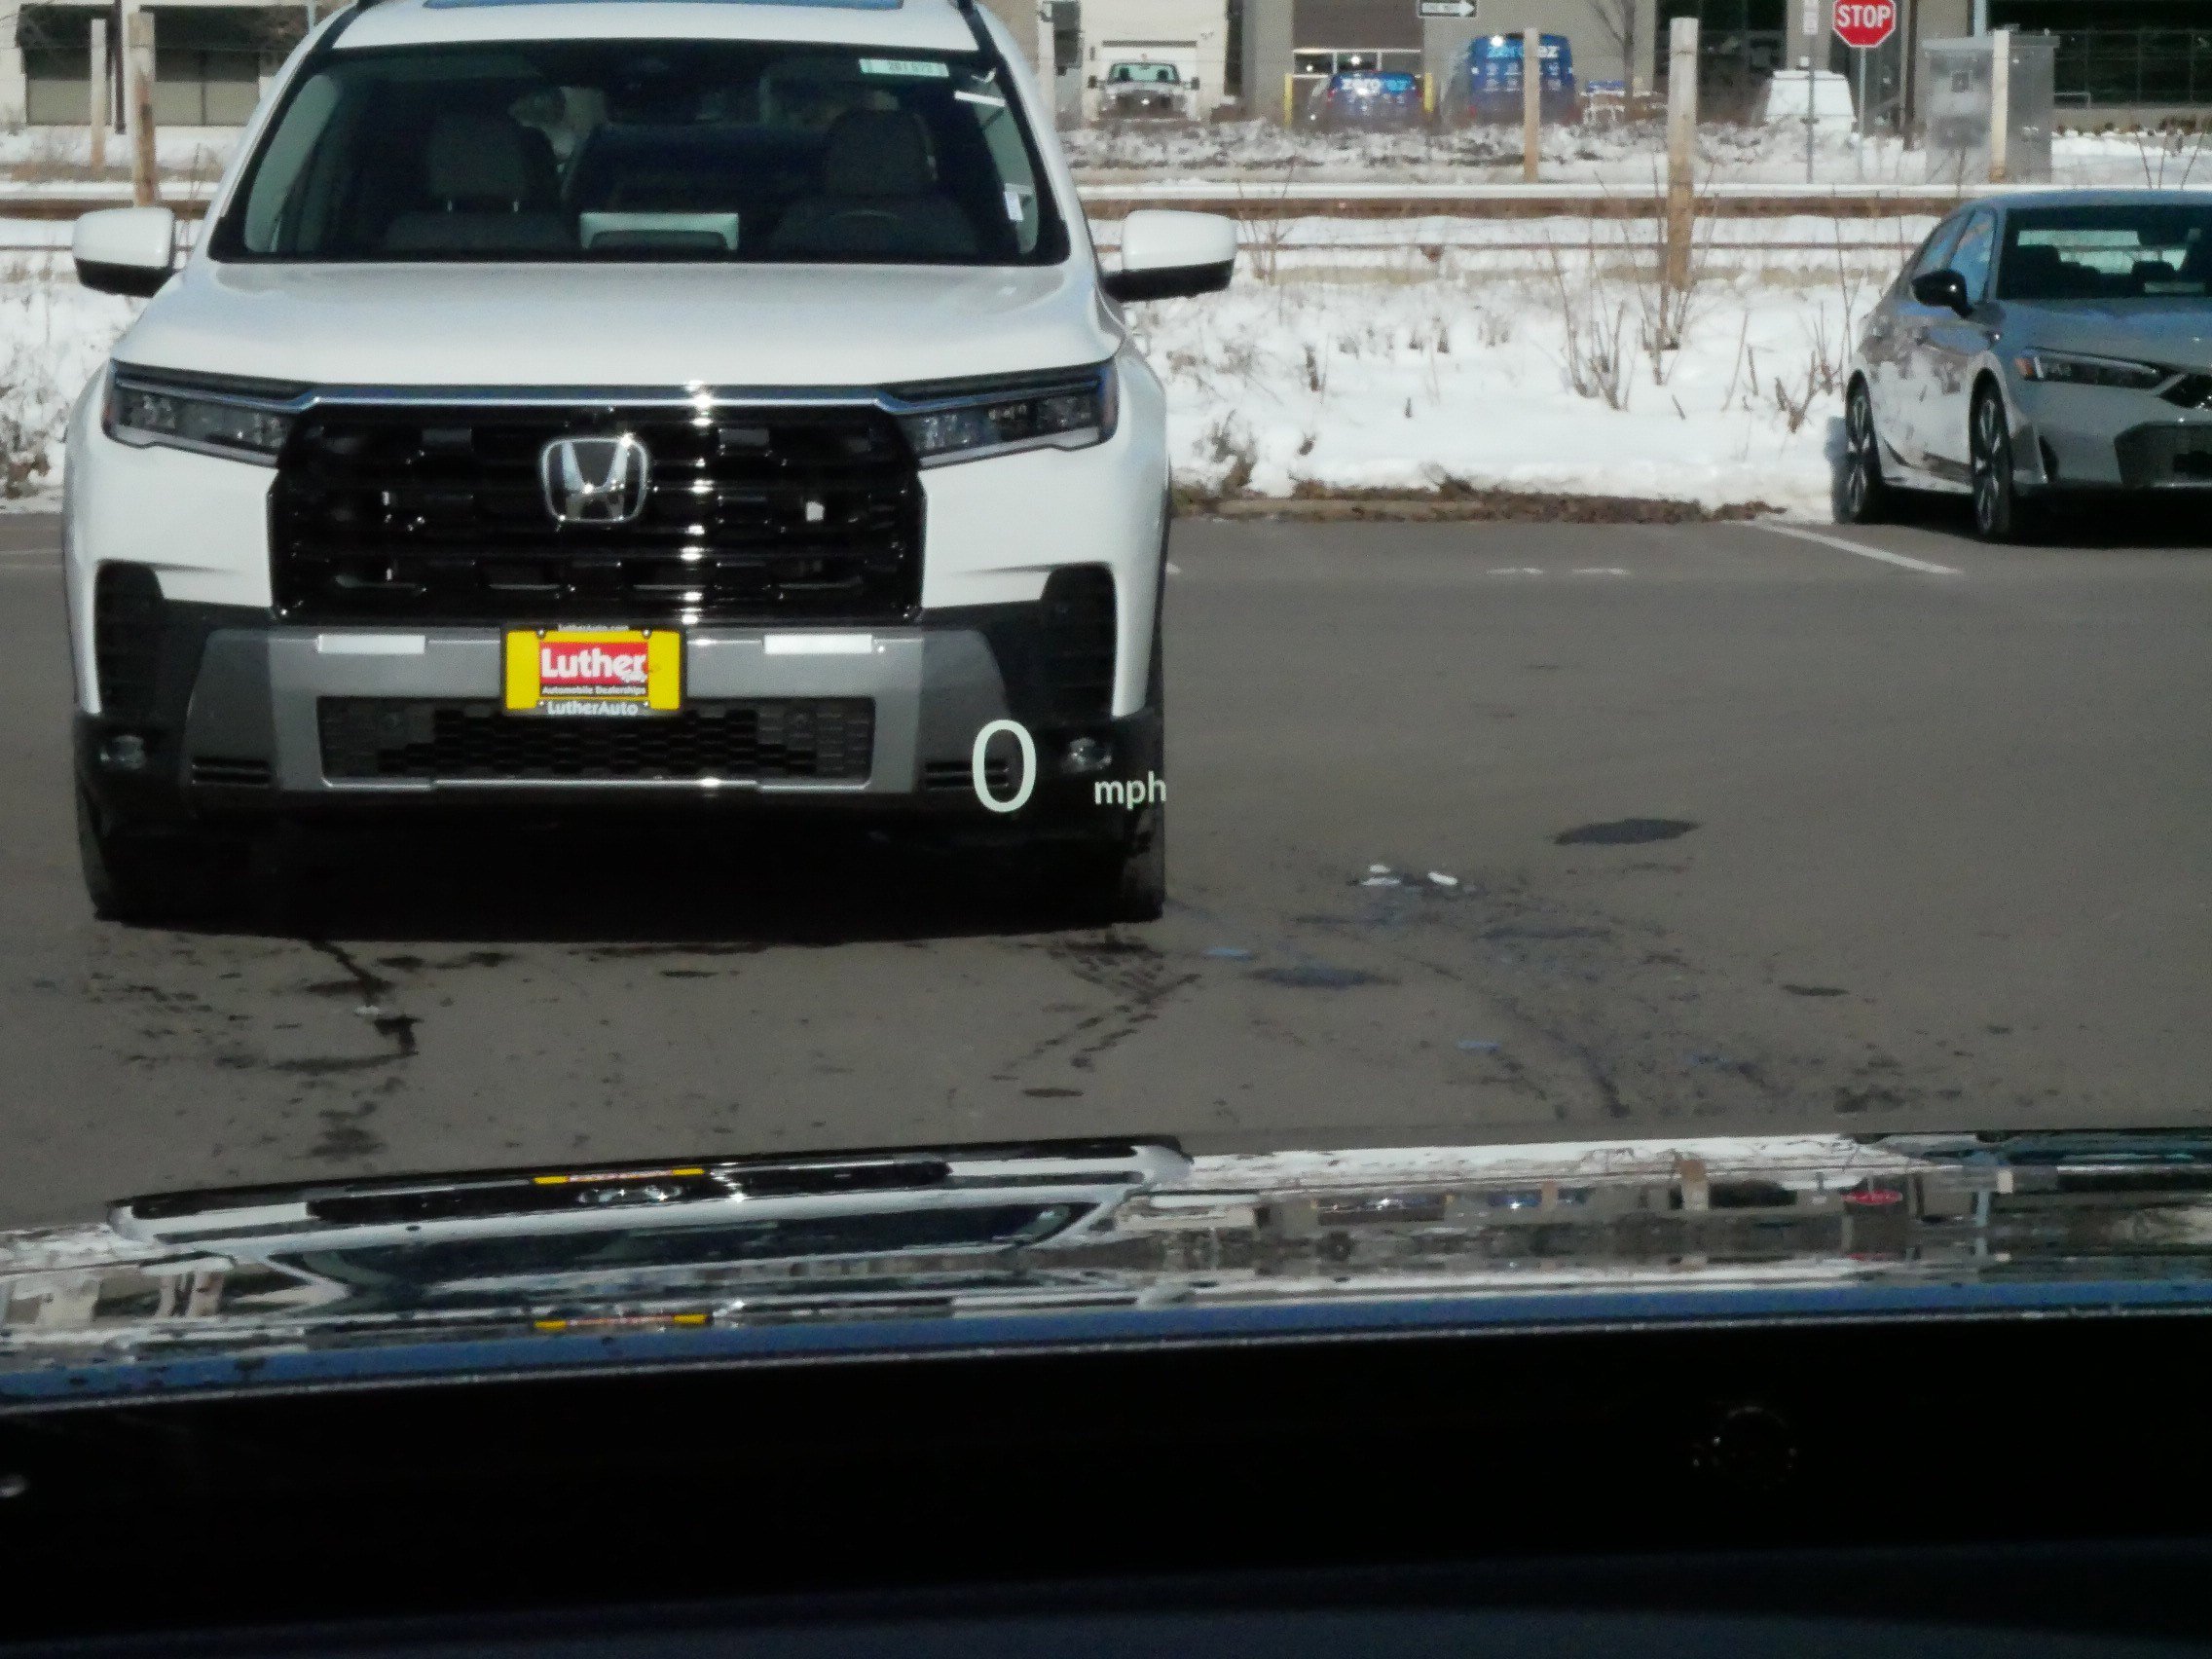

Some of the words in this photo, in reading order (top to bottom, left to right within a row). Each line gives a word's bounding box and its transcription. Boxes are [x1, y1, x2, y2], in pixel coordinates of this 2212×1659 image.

[1837, 4, 1891, 28] STOP
[540, 647, 647, 679] Luther
[972, 719, 1037, 813] 0
[1093, 770, 1167, 811] mph
